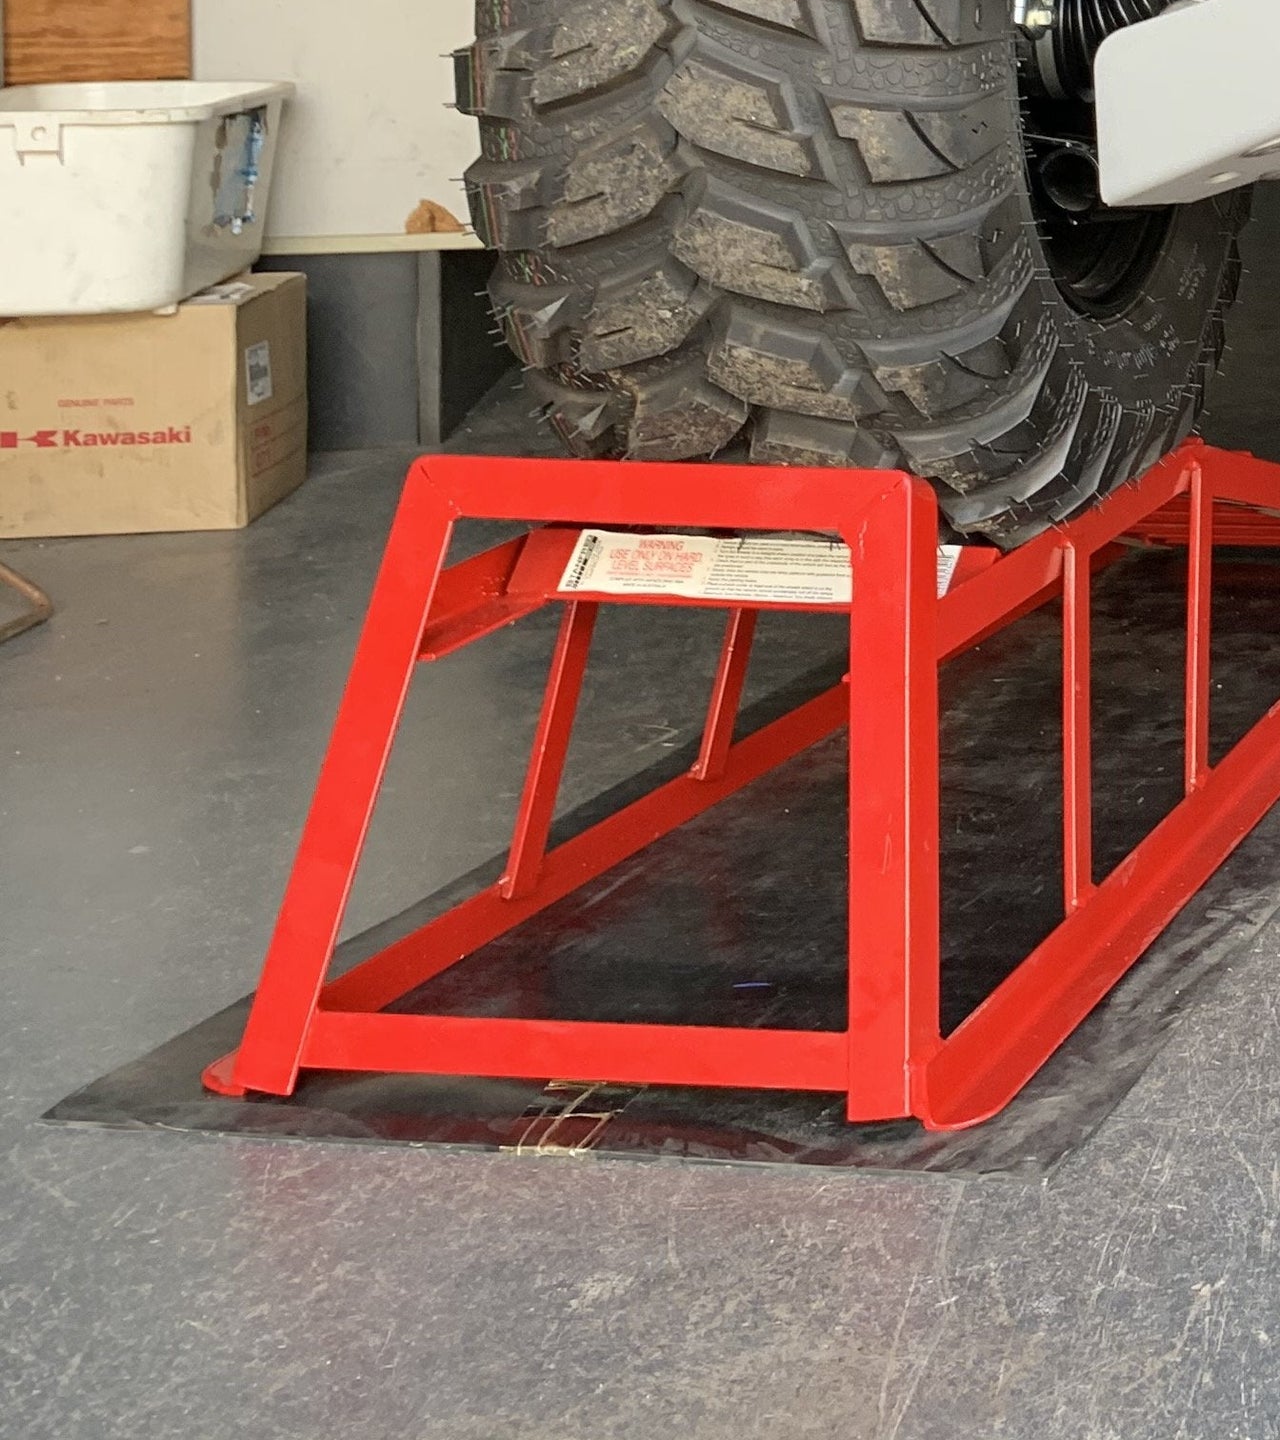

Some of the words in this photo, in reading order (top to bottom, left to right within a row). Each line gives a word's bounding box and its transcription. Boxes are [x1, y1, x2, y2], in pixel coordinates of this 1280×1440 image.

[62, 426, 192, 447] Kawasaki
[639, 540, 684, 551] WARNING
[609, 549, 631, 560] USE
[631, 549, 655, 560] ONLY
[661, 550, 673, 561] ON
[612, 560, 639, 571] LEVEL
[642, 561, 694, 573] SURFACES
